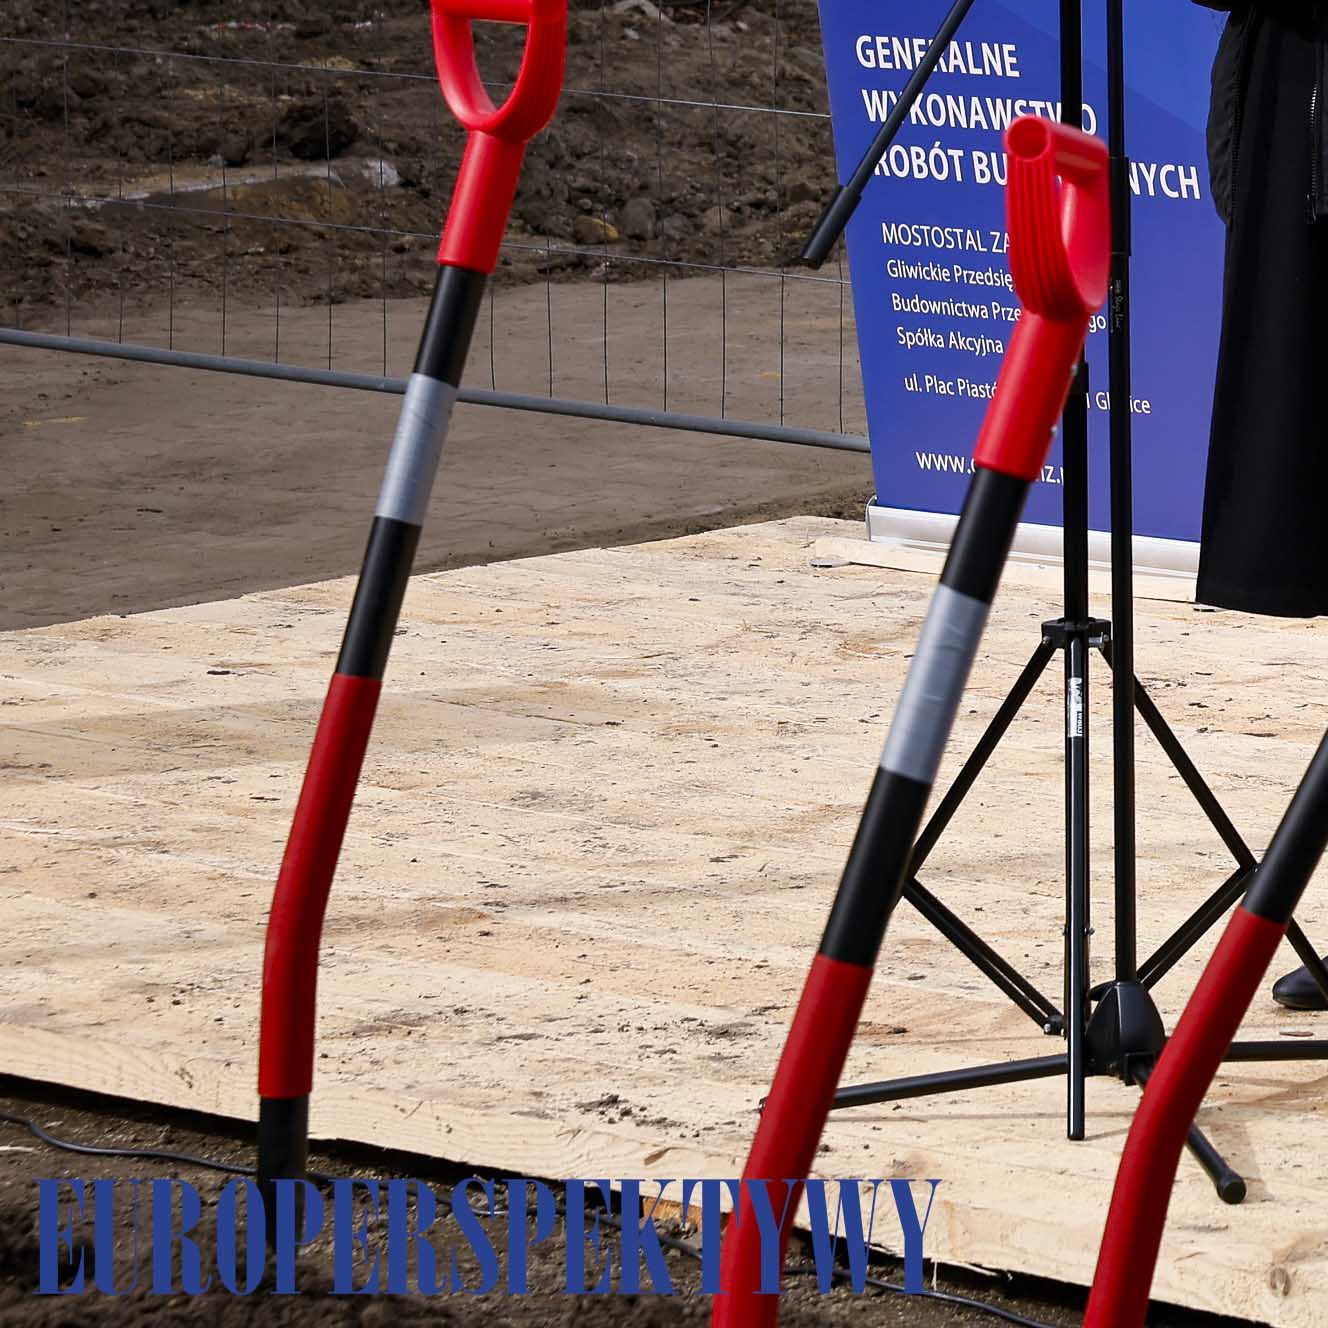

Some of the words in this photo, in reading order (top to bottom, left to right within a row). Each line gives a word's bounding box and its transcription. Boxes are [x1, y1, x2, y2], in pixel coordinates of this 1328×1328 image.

[881, 222, 988, 252] MOSTOSTAL
[886, 259, 951, 283] Gliwickie
[953, 264, 1014, 292] Przedsię
[891, 292, 989, 320] Budownictwa
[896, 326, 945, 350] Spółka
[949, 330, 1004, 357] Akcyjna
[904, 372, 923, 393] ul.
[924, 374, 955, 396] Plac
[1095, 391, 1151, 414] Glice
